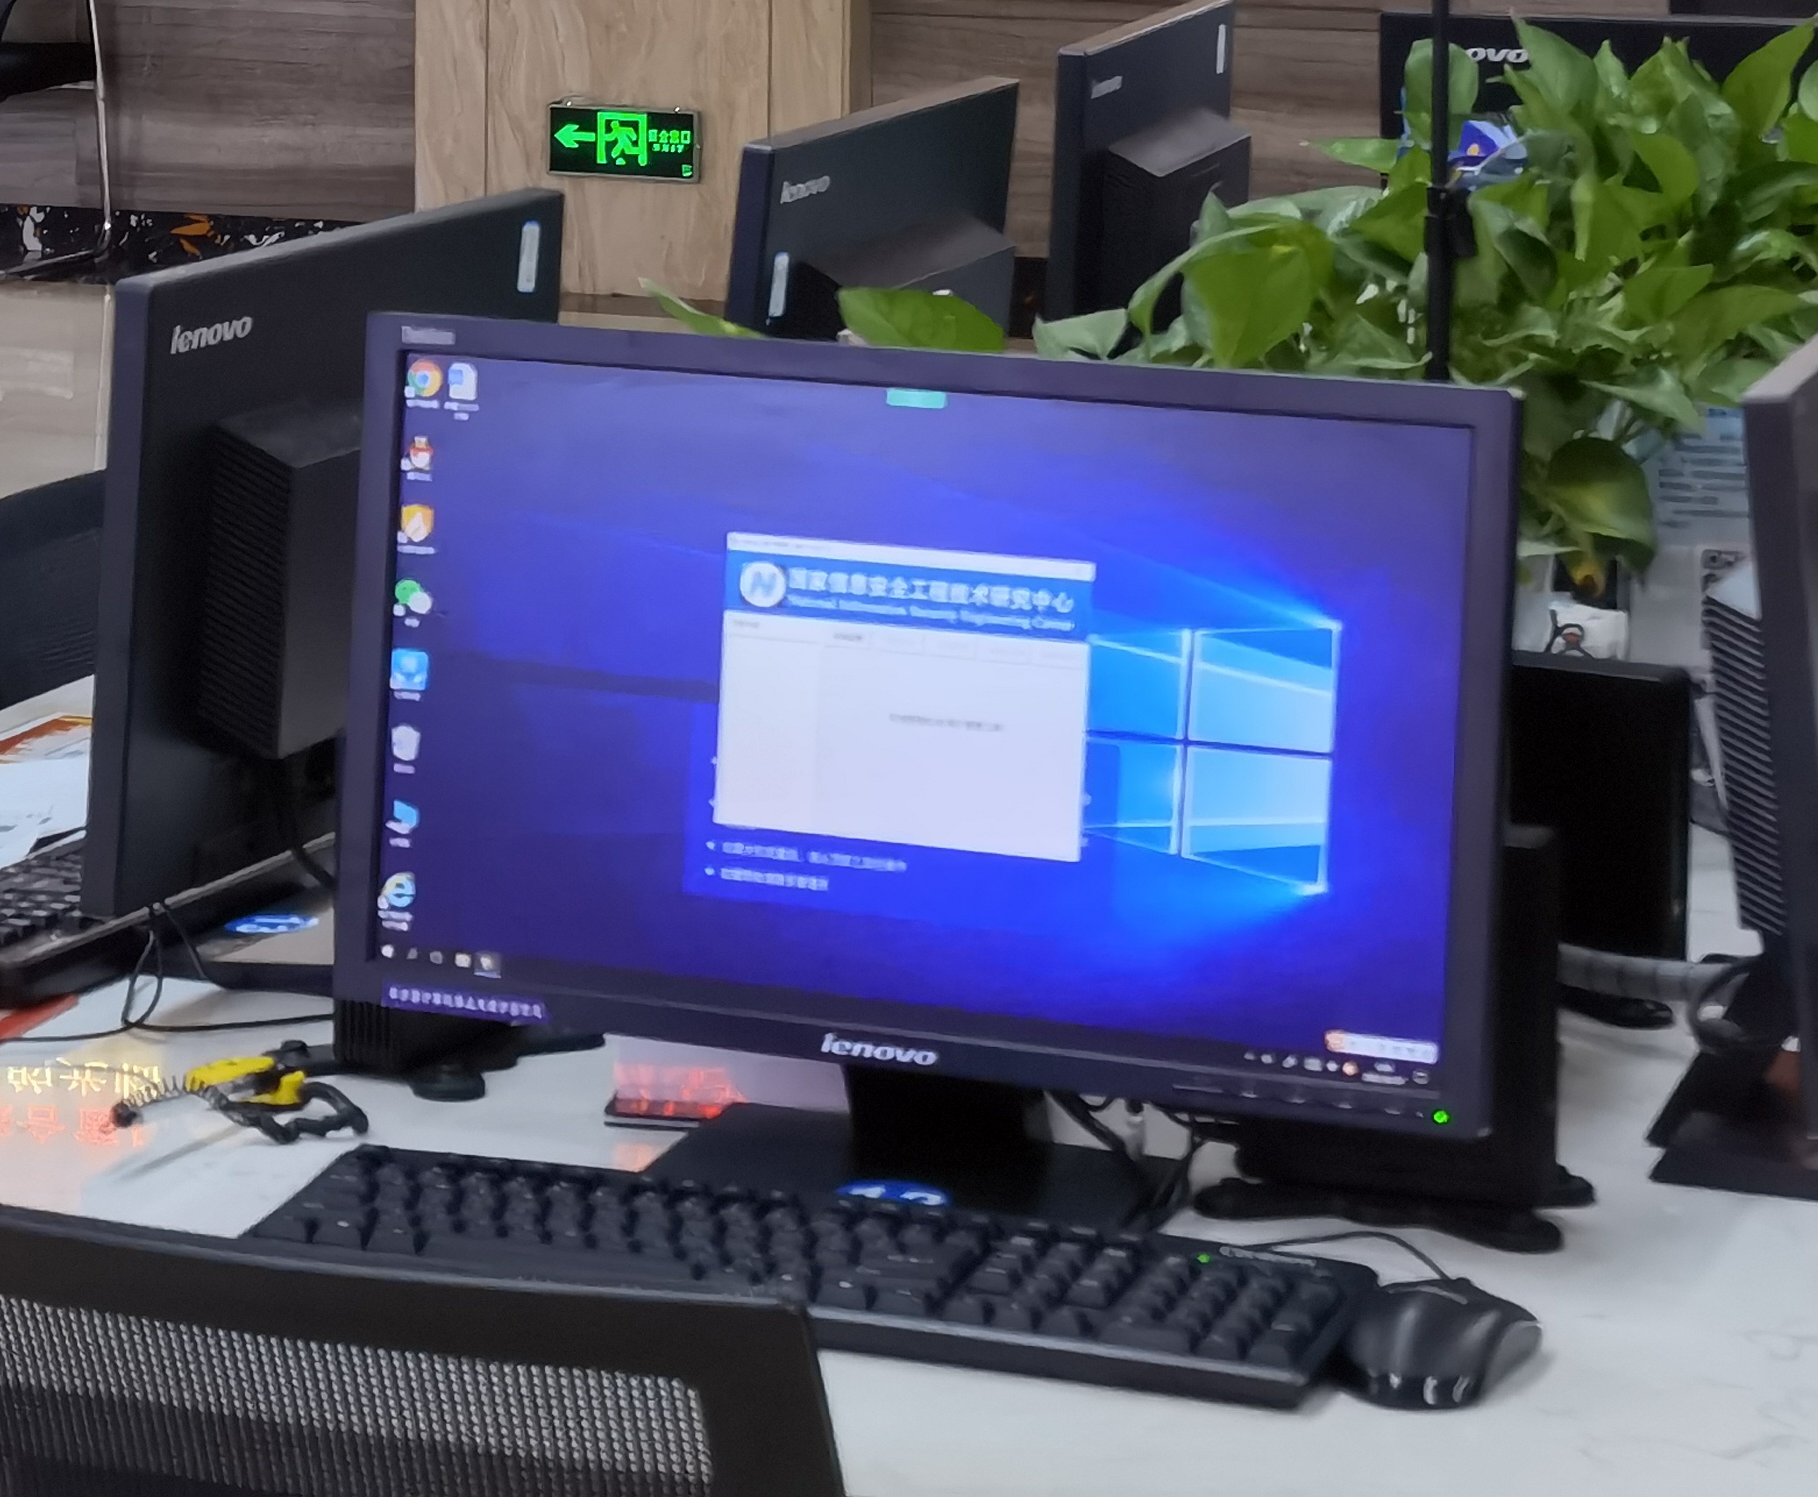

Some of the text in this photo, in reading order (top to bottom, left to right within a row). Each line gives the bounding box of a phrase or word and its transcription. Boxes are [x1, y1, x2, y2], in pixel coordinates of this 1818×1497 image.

[1465, 47, 1528, 63] ovo
[170, 316, 254, 354] lenovo
[821, 1032, 939, 1066] lenovo
